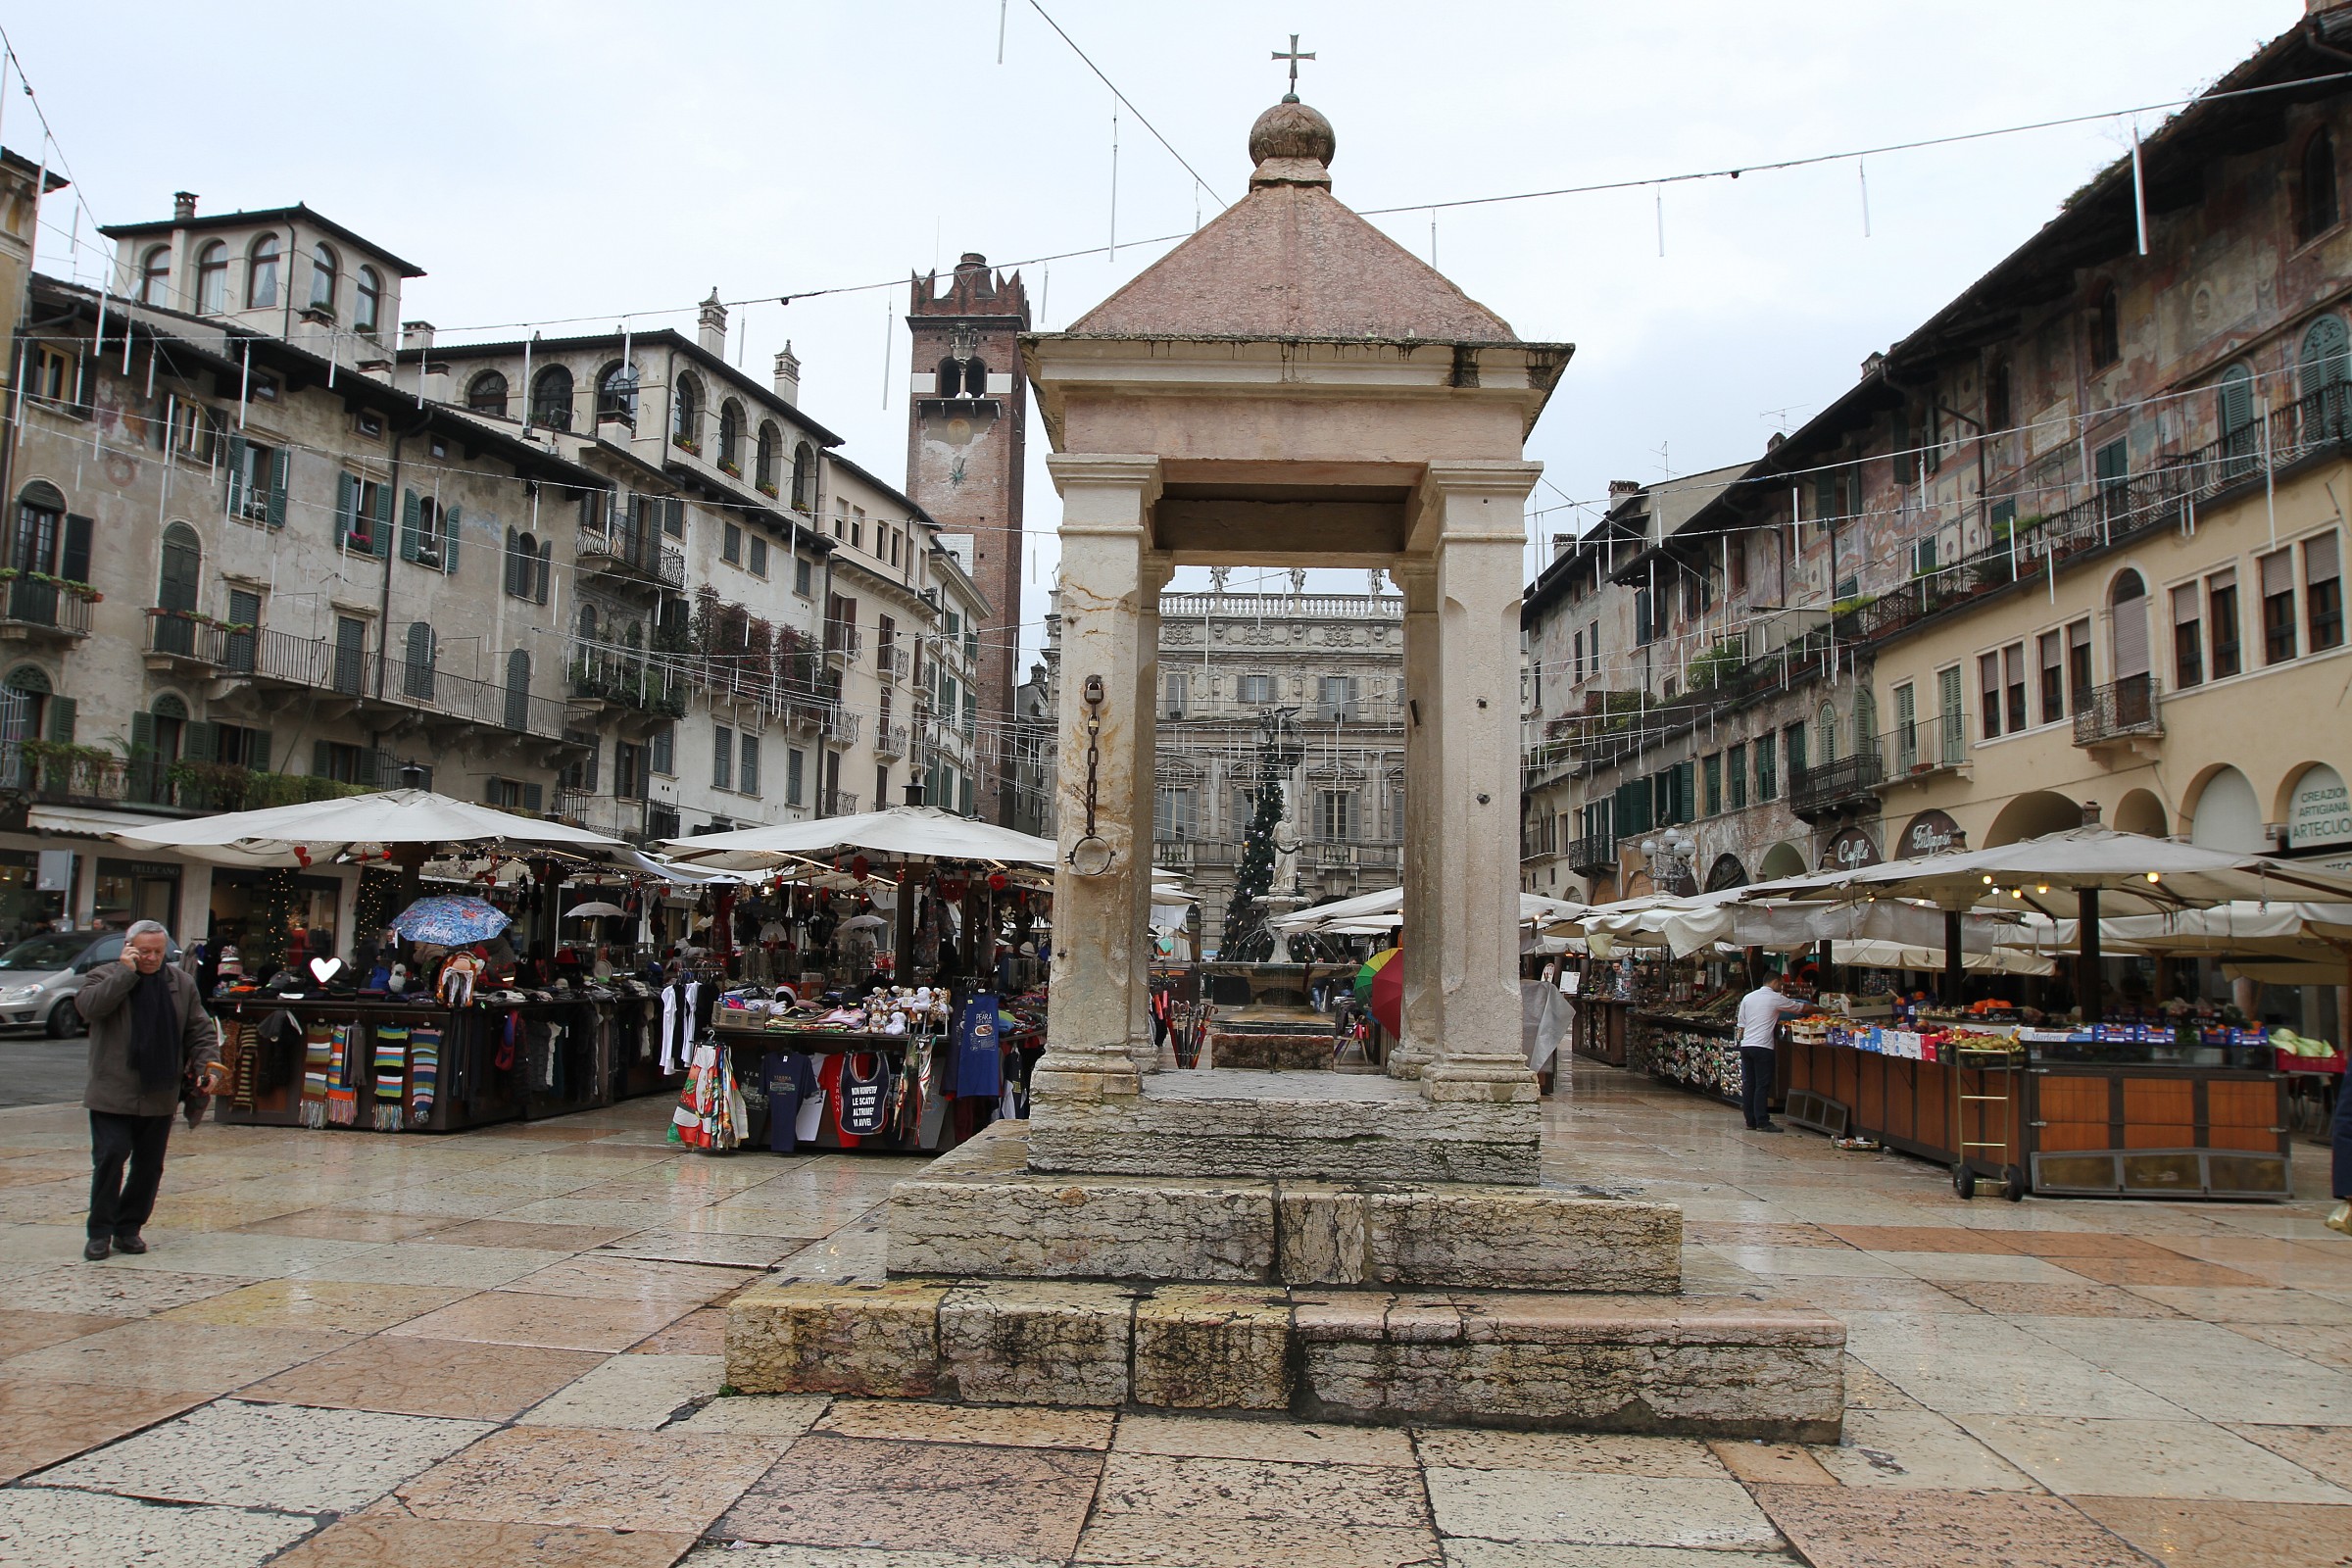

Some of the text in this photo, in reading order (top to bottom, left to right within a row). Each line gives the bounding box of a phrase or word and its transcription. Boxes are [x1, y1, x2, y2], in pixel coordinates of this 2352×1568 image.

[2301, 786, 2349, 804] CREAZION
[2298, 802, 2351, 818] ARTIGIANA
[2293, 817, 2352, 840] ARTECUO
[130, 863, 180, 876] PELLICANO
[2032, 1033, 2063, 1042] Marlene
[852, 1098, 859, 1106] LE
